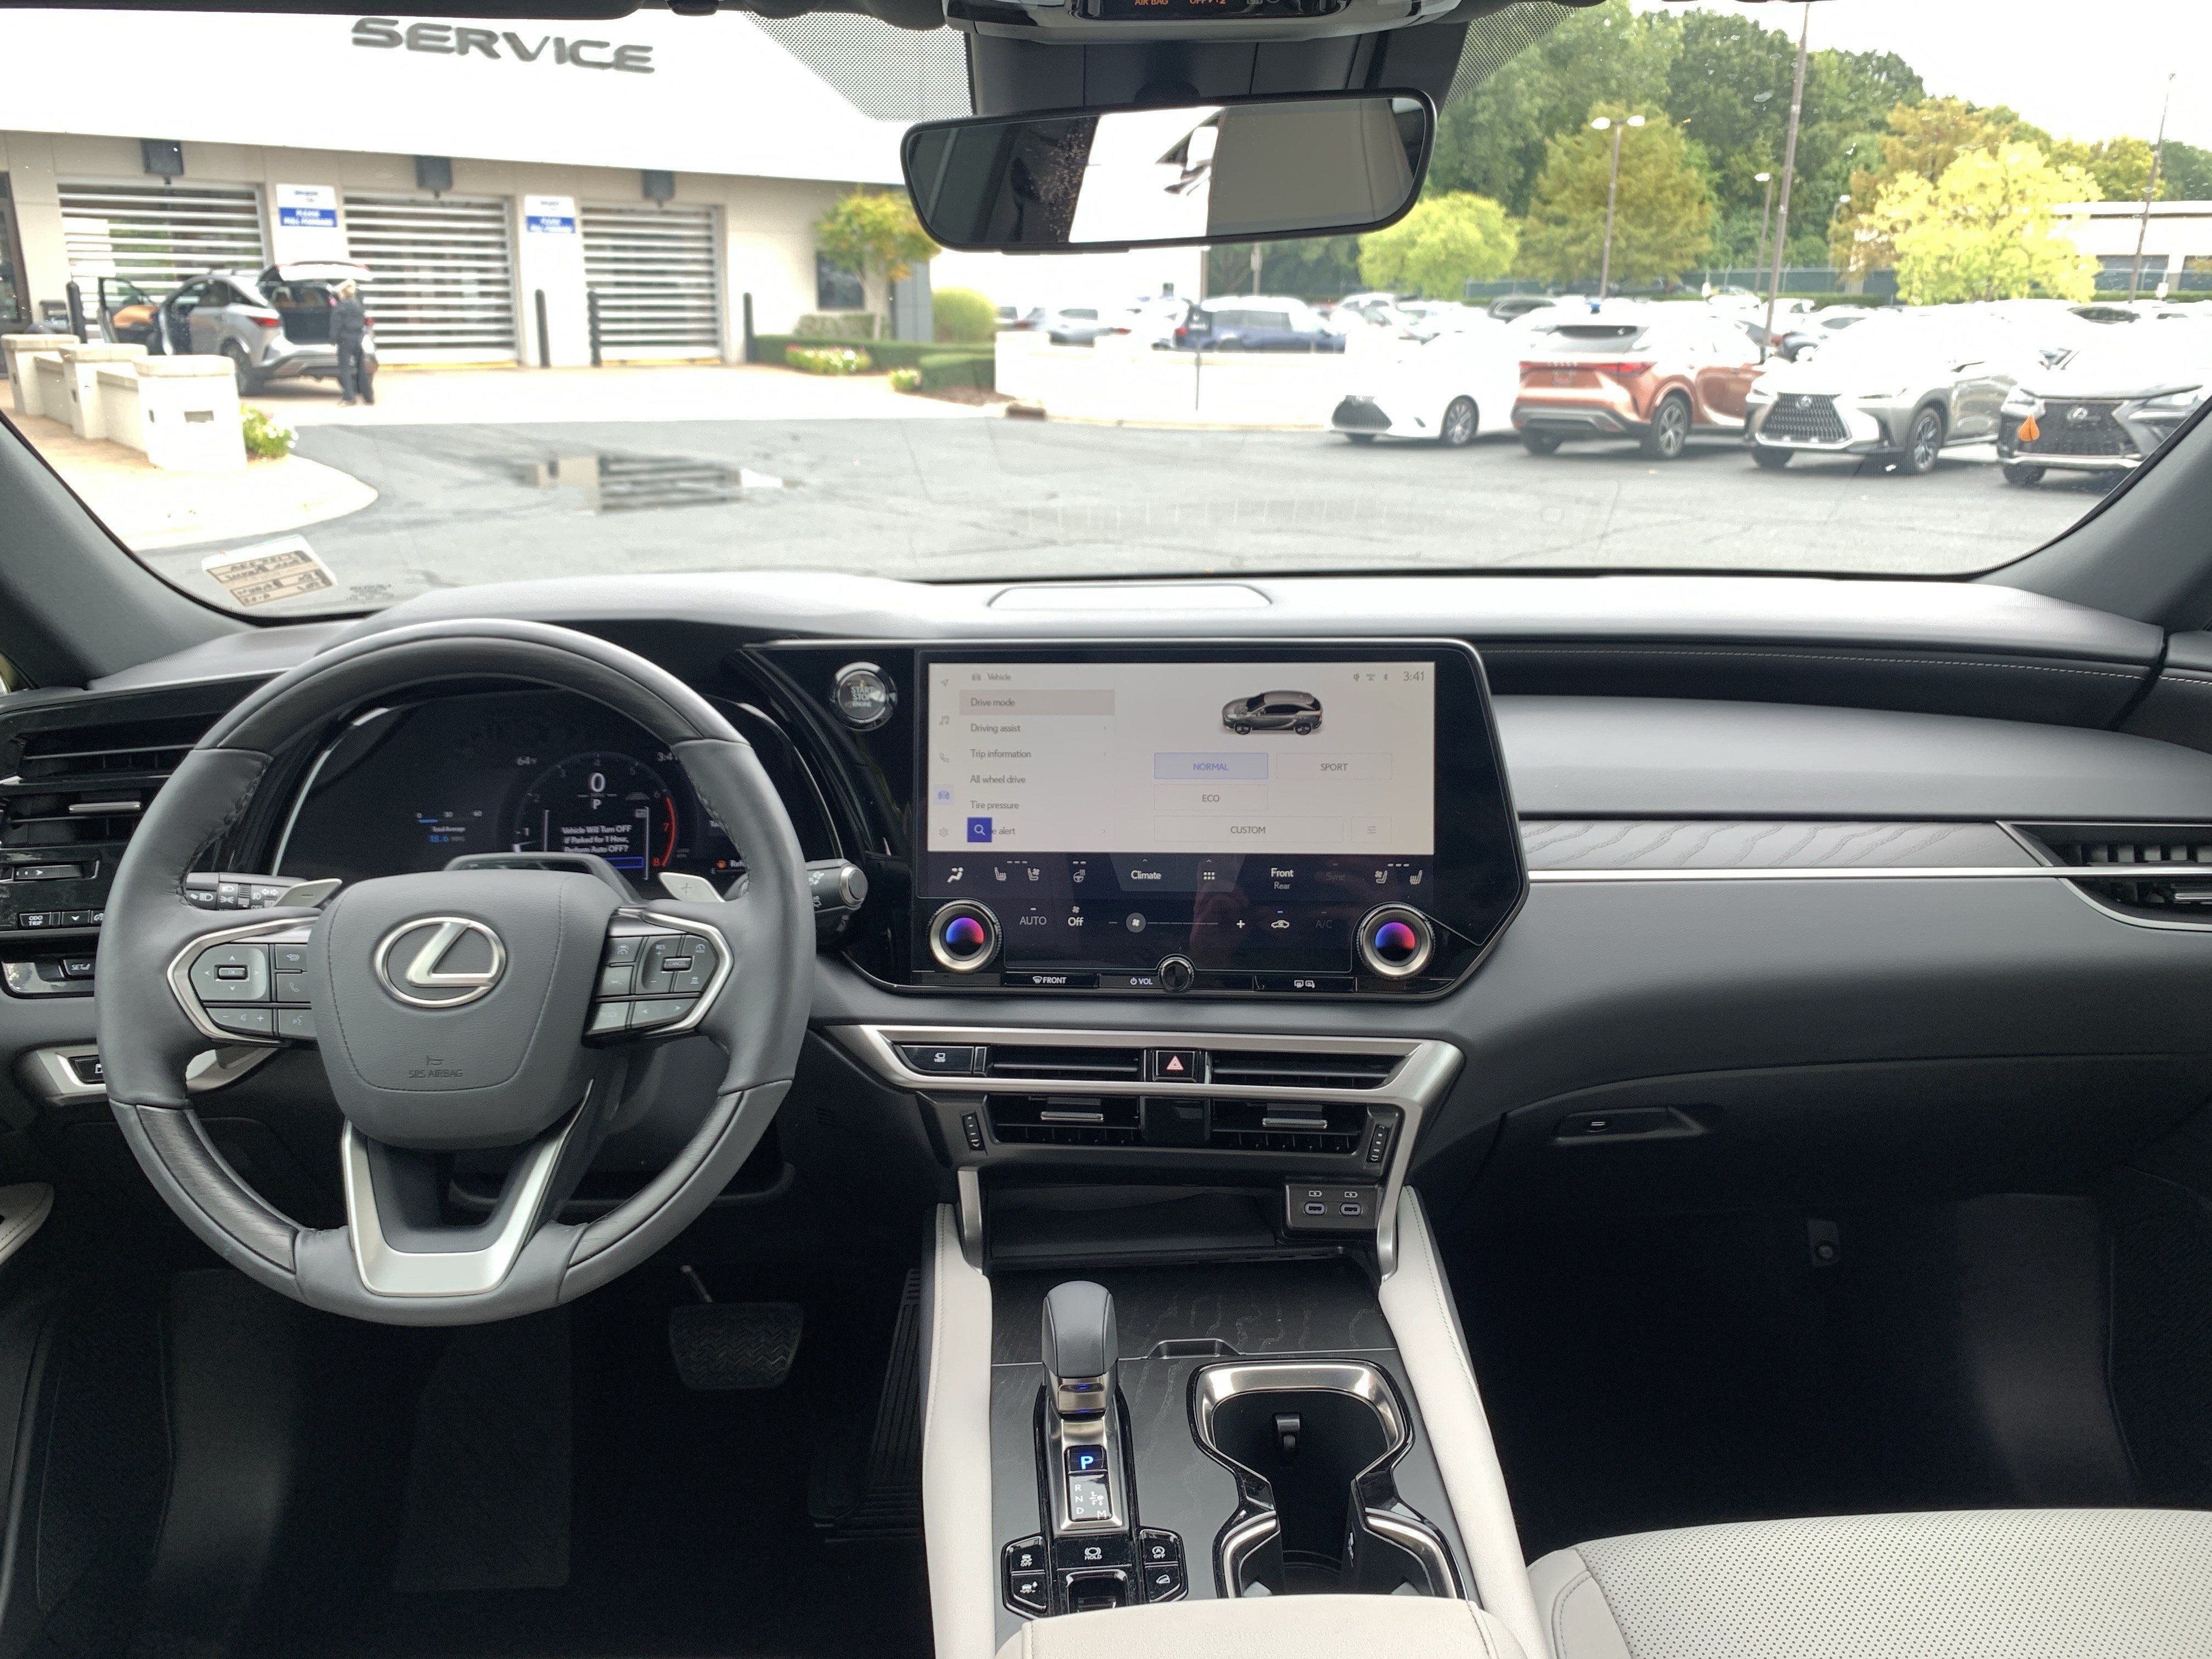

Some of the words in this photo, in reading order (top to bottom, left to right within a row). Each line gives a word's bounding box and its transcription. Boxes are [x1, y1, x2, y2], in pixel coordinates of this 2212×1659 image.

[351, 17, 655, 74] SERVICE
[988, 673, 1011, 681] Vehicle
[1403, 670, 1425, 681] 3:41
[970, 697, 992, 707] Drive
[994, 697, 1015, 707] mode
[970, 723, 998, 734] Driving
[1000, 724, 1021, 732] assist
[970, 748, 986, 759] Trip
[988, 748, 1031, 758] information
[1192, 763, 1229, 771] NORMAL
[1320, 763, 1348, 771] SPORT
[591, 772, 605, 792] 0
[970, 775, 980, 783] All
[982, 775, 1005, 783] wheel
[1006, 775, 1026, 783] drive
[1202, 794, 1220, 803] ECO
[592, 799, 601, 810] P
[970, 800, 985, 809] Tire
[987, 802, 1020, 811] pressure
[615, 825, 632, 833] OFF
[998, 826, 1015, 834] alert
[1230, 826, 1266, 834] CUSTOM
[608, 844, 629, 853] OFF?
[1130, 870, 1162, 880] Climate
[1271, 867, 1294, 878] Front
[1273, 881, 1290, 890] Rear
[1019, 916, 1047, 926] AUTO
[1068, 917, 1084, 927] Off
[1042, 977, 1067, 985] FRONT
[1138, 977, 1153, 986] VOL
[428, 1069, 464, 1077] AIRBAG
[1081, 1456, 1093, 1470] P
[1097, 1509, 1107, 1519] M
